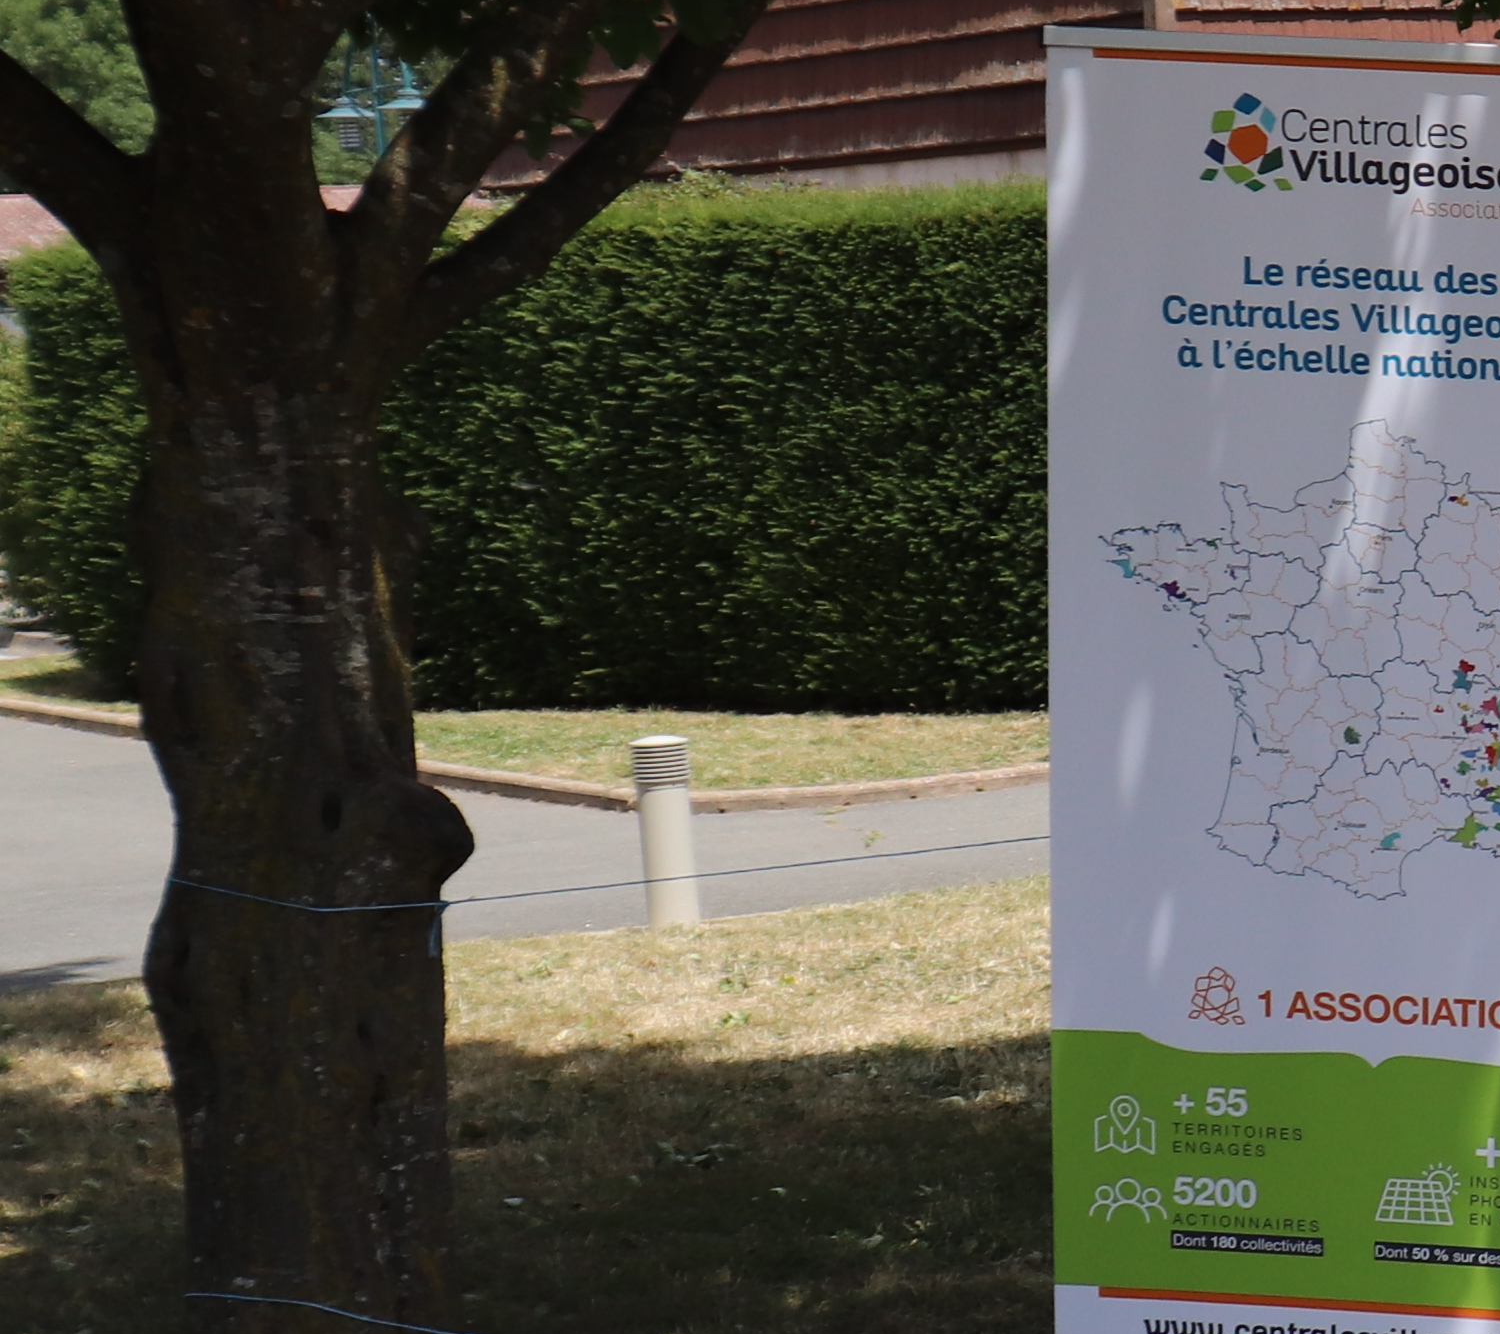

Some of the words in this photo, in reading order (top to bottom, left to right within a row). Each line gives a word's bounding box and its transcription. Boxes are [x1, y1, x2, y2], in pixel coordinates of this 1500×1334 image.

[1281, 108, 1468, 150] Centrales
[1243, 255, 1284, 286] Le
[1296, 258, 1422, 293] réseau
[1434, 264, 1498, 295] des
[1162, 294, 1339, 332] Centrales
[1177, 337, 1202, 368] à
[1213, 339, 1370, 375] l'échelle
[1256, 991, 1273, 1018] 1
[1206, 1087, 1248, 1117] 55
[1173, 1122, 1303, 1141] TERRITOIRES
[1173, 1141, 1266, 1157] ENGAGÉS
[1173, 1176, 1258, 1209] 5200
[1172, 1213, 1320, 1233] ACTIONNAIRES
[1470, 1213, 1491, 1226] EN
[1173, 1233, 1206, 1247] Dont
[1211, 1236, 1237, 1248] 180
[1240, 1237, 1322, 1254] collectivités
[1375, 1245, 1408, 1259] Dont
[1412, 1248, 1431, 1261] 50
[1433, 1249, 1449, 1262] %
[1453, 1252, 1475, 1263] sur
